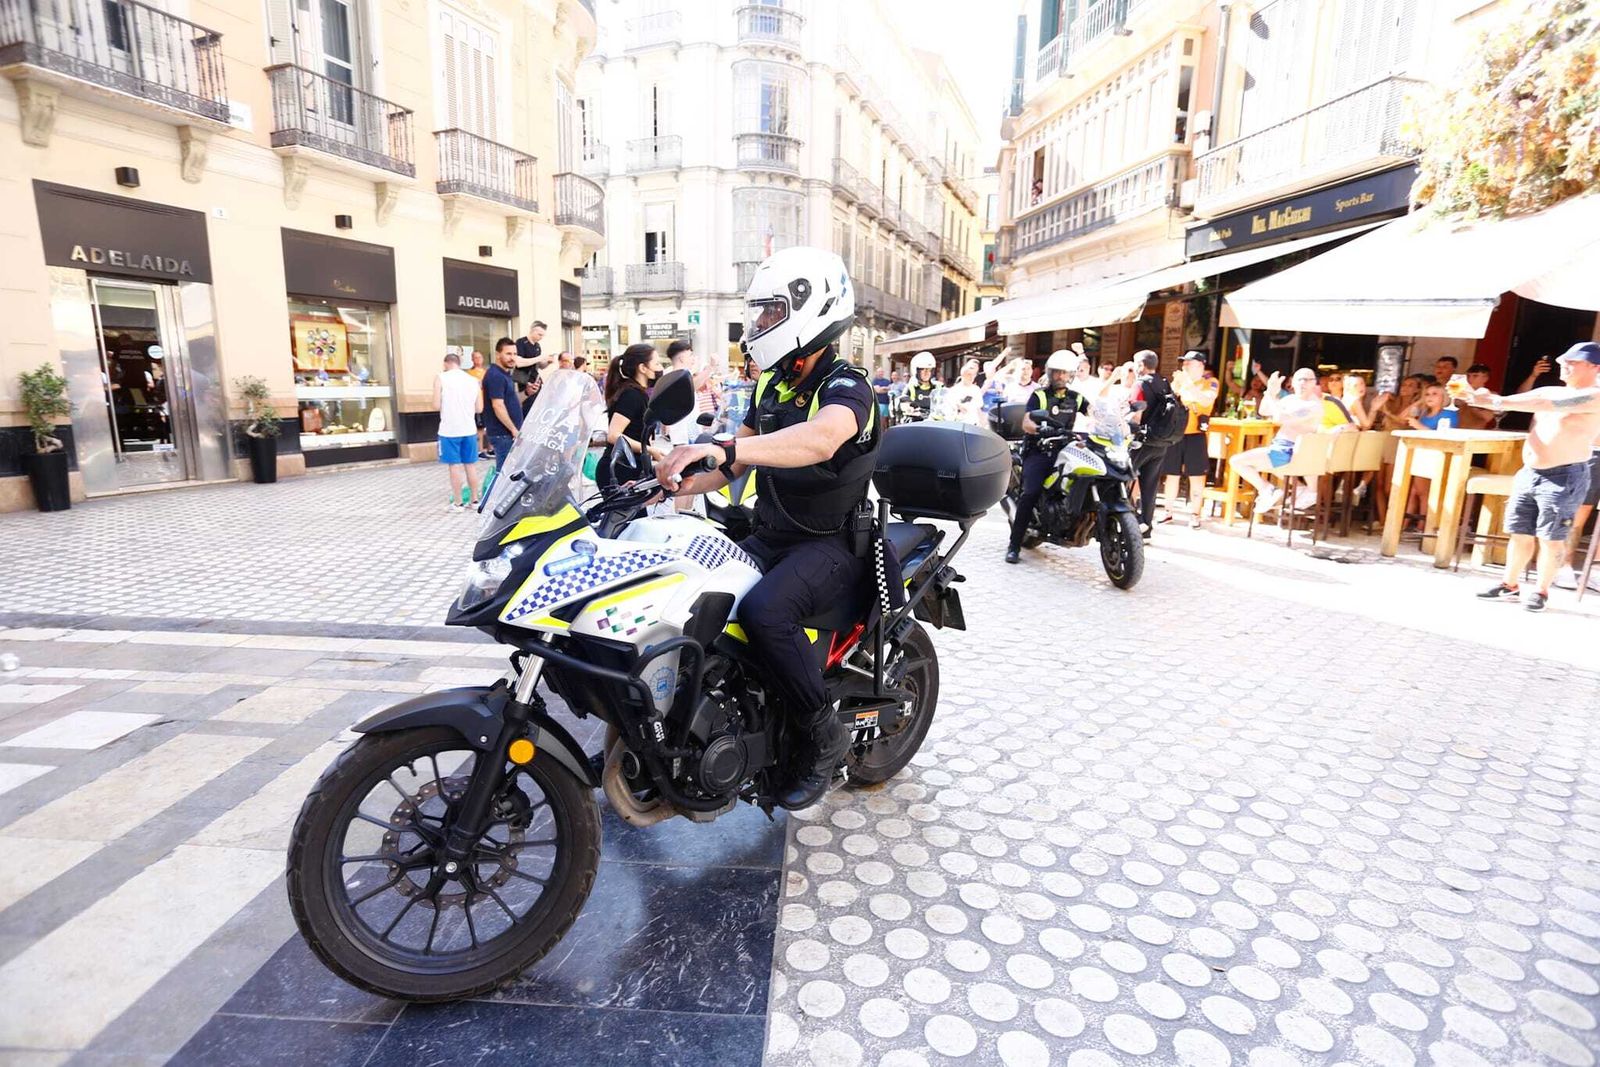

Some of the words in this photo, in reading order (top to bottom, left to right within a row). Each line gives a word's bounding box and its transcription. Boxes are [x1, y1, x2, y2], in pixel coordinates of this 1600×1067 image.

[1335, 195, 1360, 212] Sports
[1359, 192, 1375, 205] Bar
[70, 245, 193, 276] ADELAIDA
[458, 296, 510, 312] ADELAIDA
